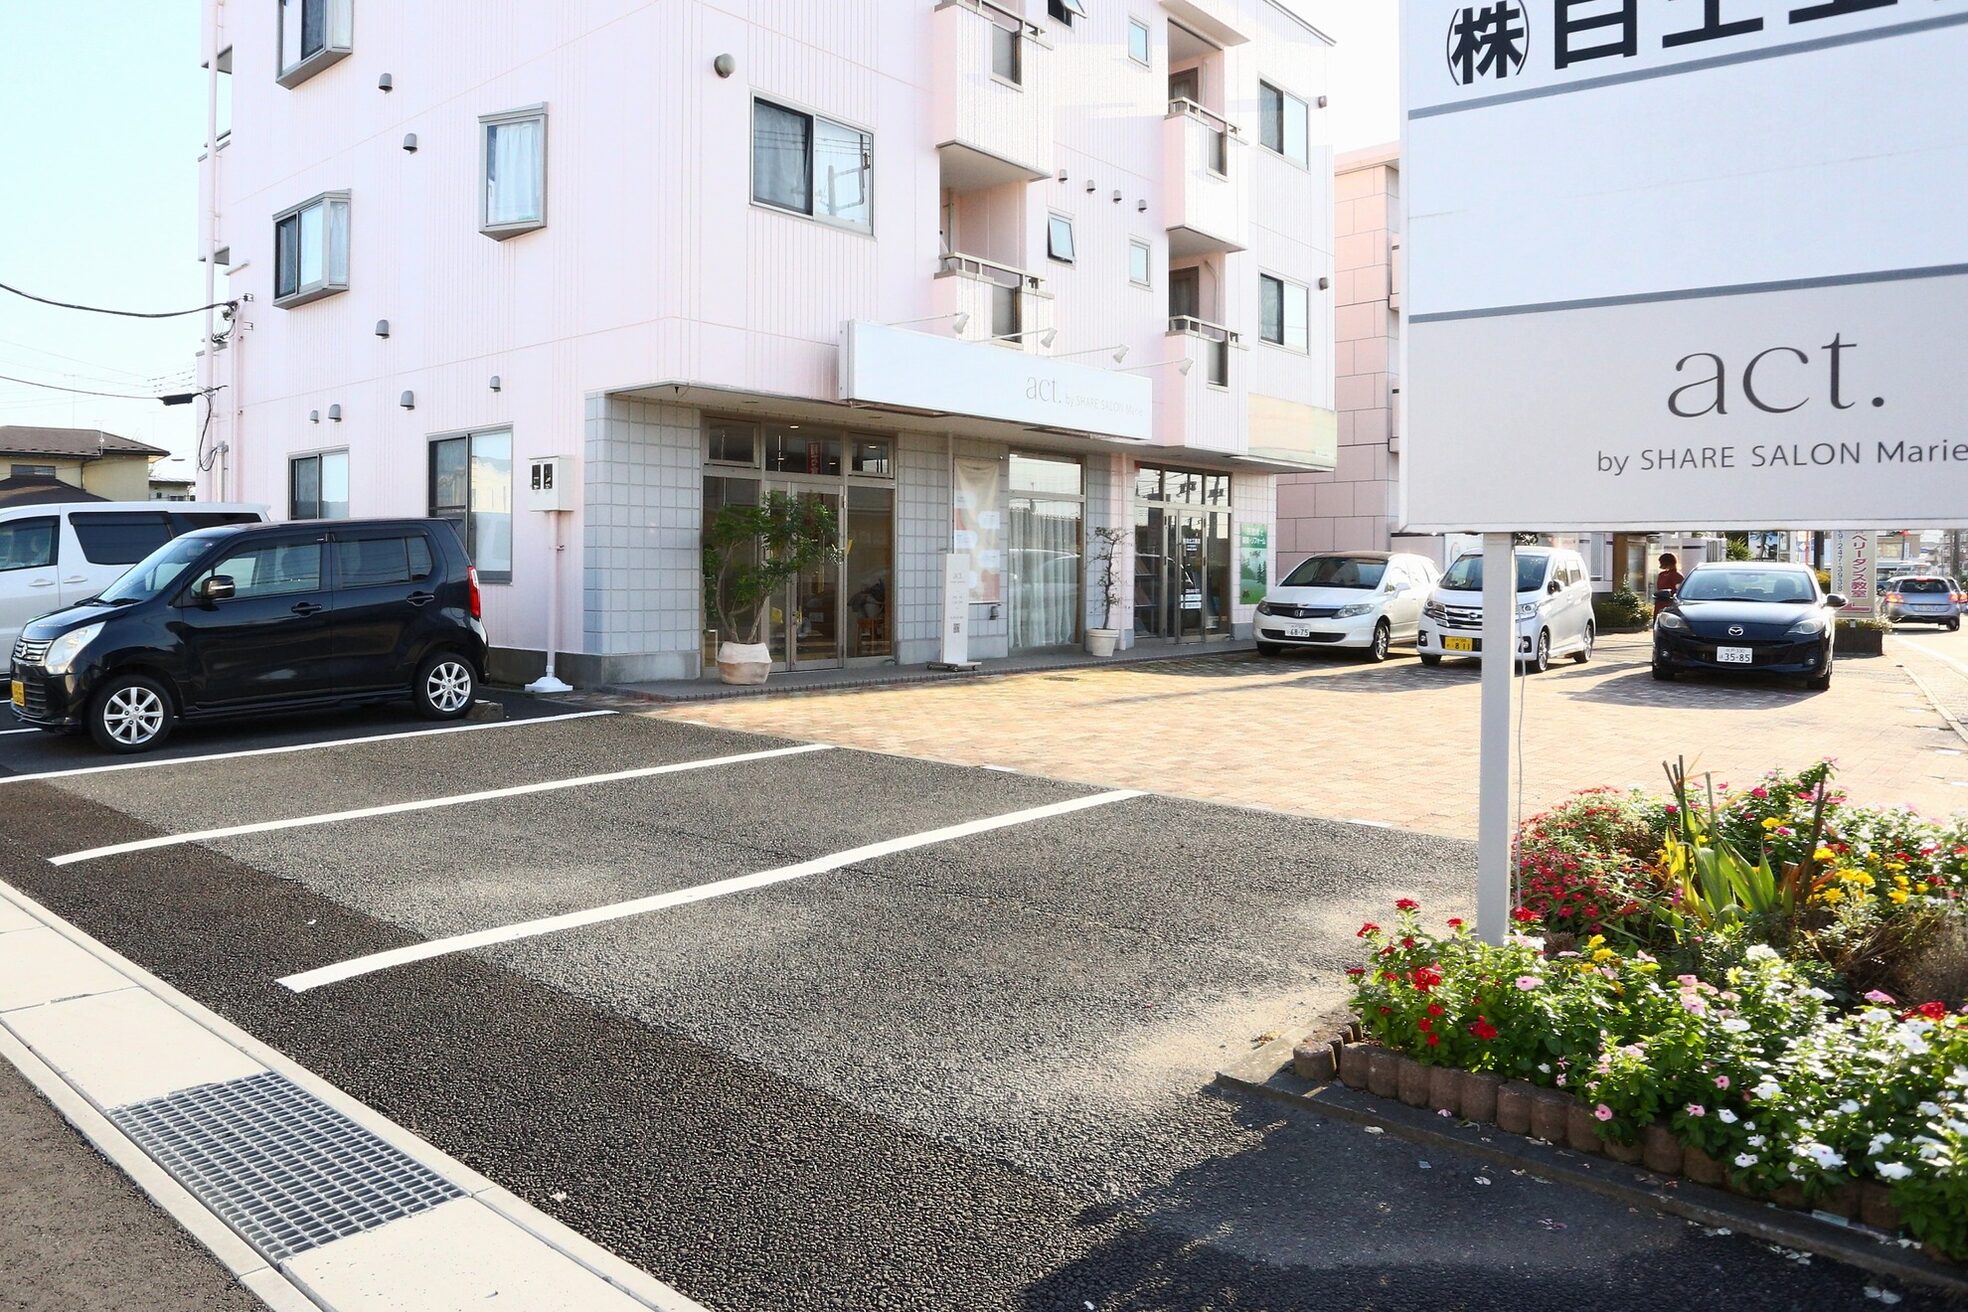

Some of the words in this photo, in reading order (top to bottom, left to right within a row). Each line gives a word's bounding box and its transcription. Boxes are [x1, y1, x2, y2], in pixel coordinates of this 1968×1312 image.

[1667, 332, 1885, 418] act.
[1025, 376, 1062, 404] act.
[1076, 395, 1098, 409] SHARE
[1101, 398, 1123, 413] SALON
[1599, 451, 1629, 476] by
[1641, 447, 1734, 470] SHARE
[1752, 442, 1859, 467] SALON
[1878, 440, 1968, 463] Marie
[1724, 652, 1751, 662] 35-85
